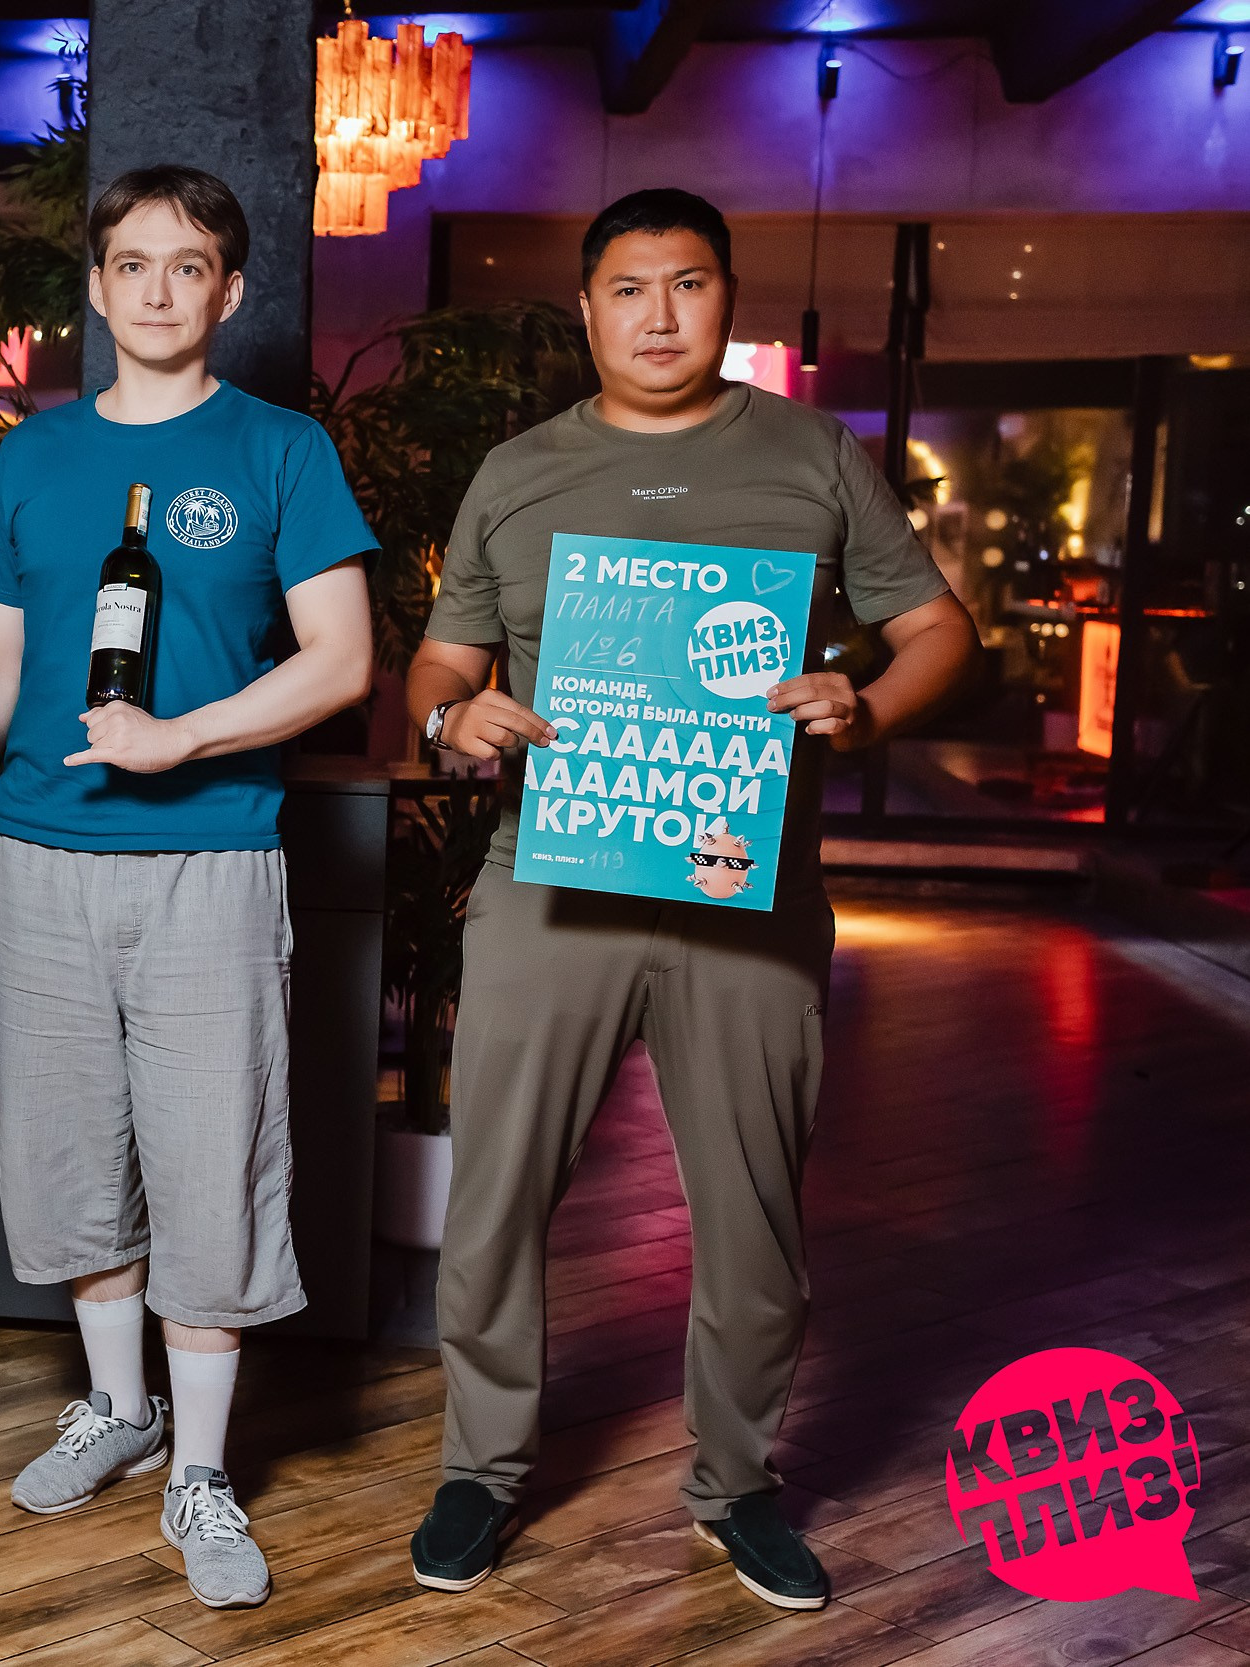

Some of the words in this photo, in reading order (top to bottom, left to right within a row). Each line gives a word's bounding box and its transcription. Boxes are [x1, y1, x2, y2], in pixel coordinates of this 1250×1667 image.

[175, 490, 206, 507] PHUKET
[208, 491, 233, 513] ISLAND
[632, 488, 656, 496] Marc
[658, 486, 688, 495] O'Polo
[178, 532, 221, 547] THAILAND
[564, 552, 587, 582] 2
[596, 555, 728, 594] МЕСТО
[114, 601, 141, 613] Nostra
[556, 591, 676, 624] ПАЛАТА
[691, 615, 787, 653] КВИЗ,
[691, 643, 789, 681] ПЛИЗ!
[551, 675, 653, 702] КОМАНДЕ,
[549, 696, 640, 719] КОТОРАЯ
[642, 706, 699, 726] БЫЛА
[702, 711, 772, 733] ПОЧТИ
[532, 852, 554, 863] КВИЗ,
[555, 855, 578, 864] ПЛИЗ!
[588, 850, 624, 870] 119
